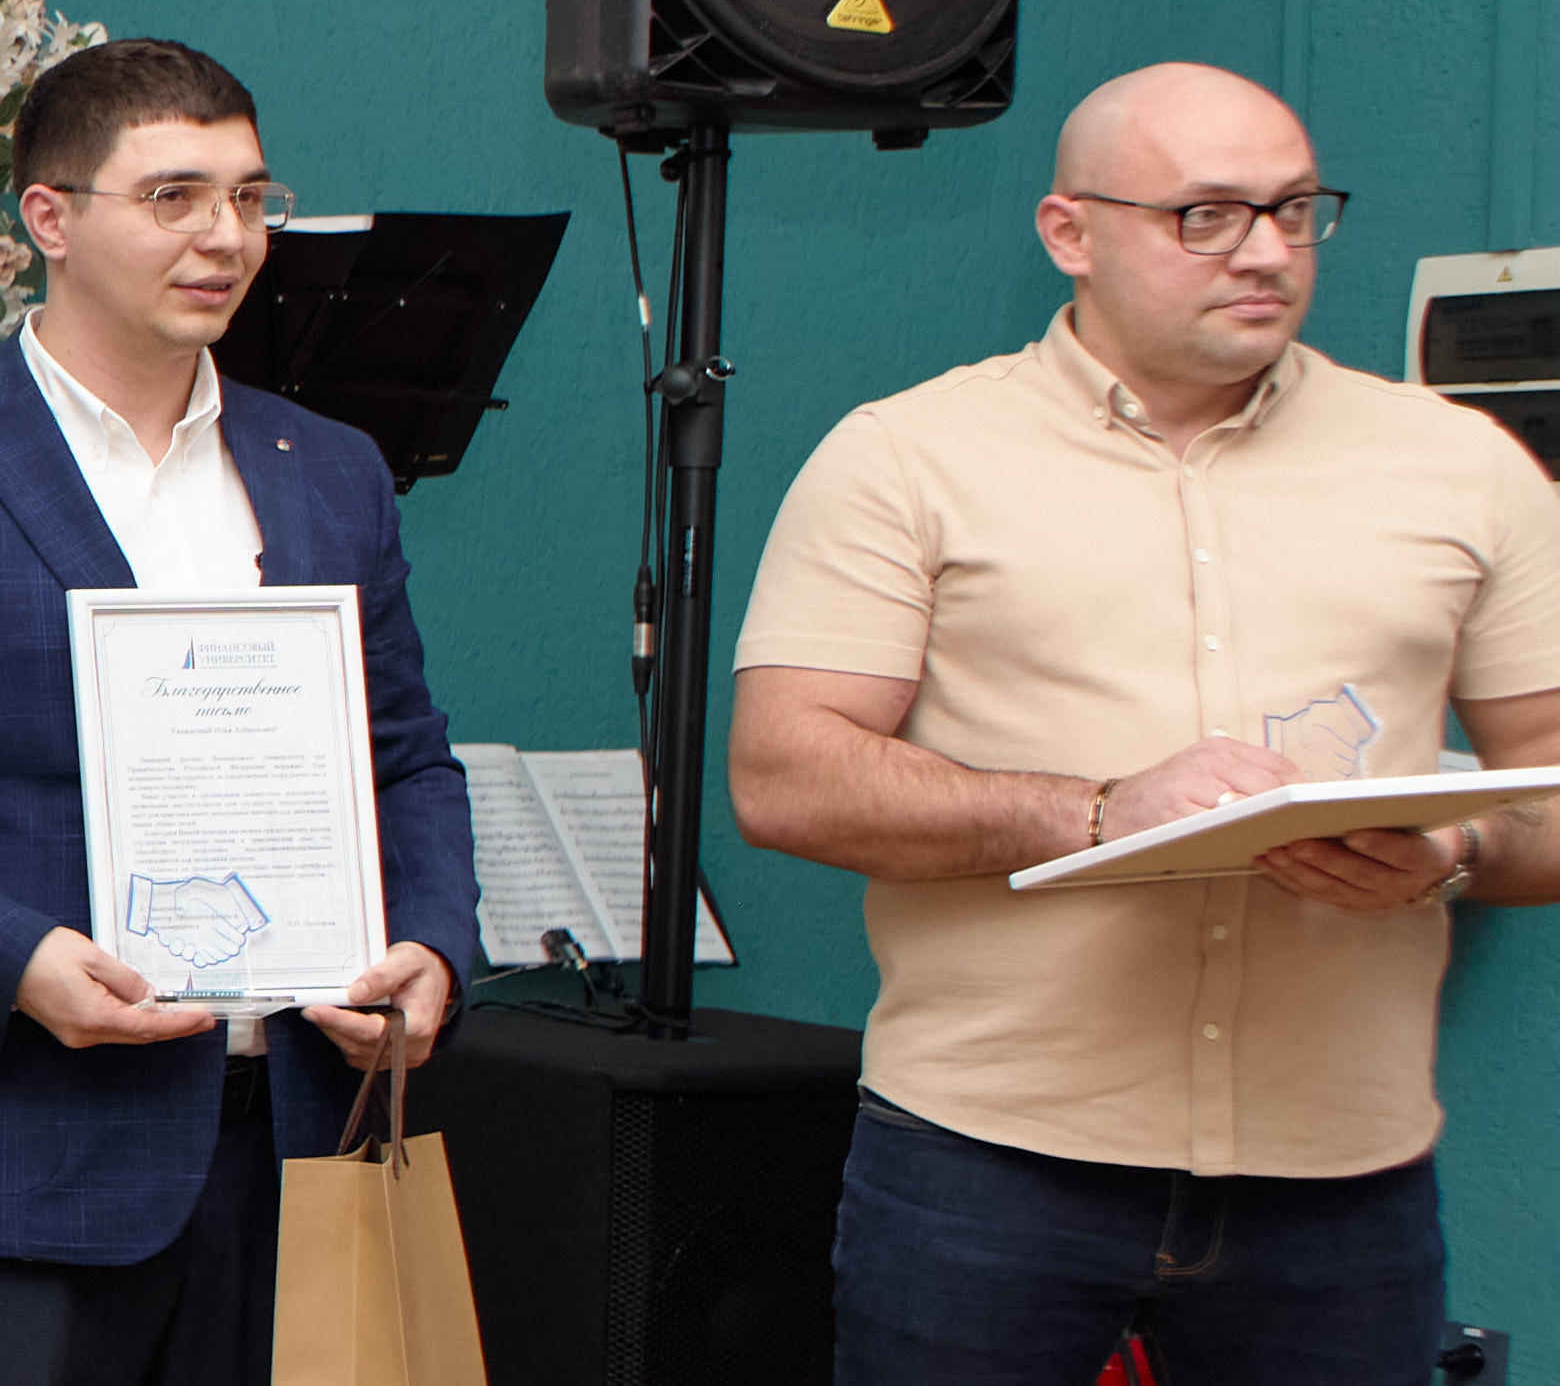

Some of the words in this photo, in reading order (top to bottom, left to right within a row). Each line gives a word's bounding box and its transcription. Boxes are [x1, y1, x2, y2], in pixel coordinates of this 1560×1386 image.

[197, 641, 275, 652] ФИНАНСОВЫЙ
[198, 654, 275, 664] УНИВЕРСИТЕТ
[141, 676, 303, 702] Благодарственное
[194, 706, 252, 717] письмо
